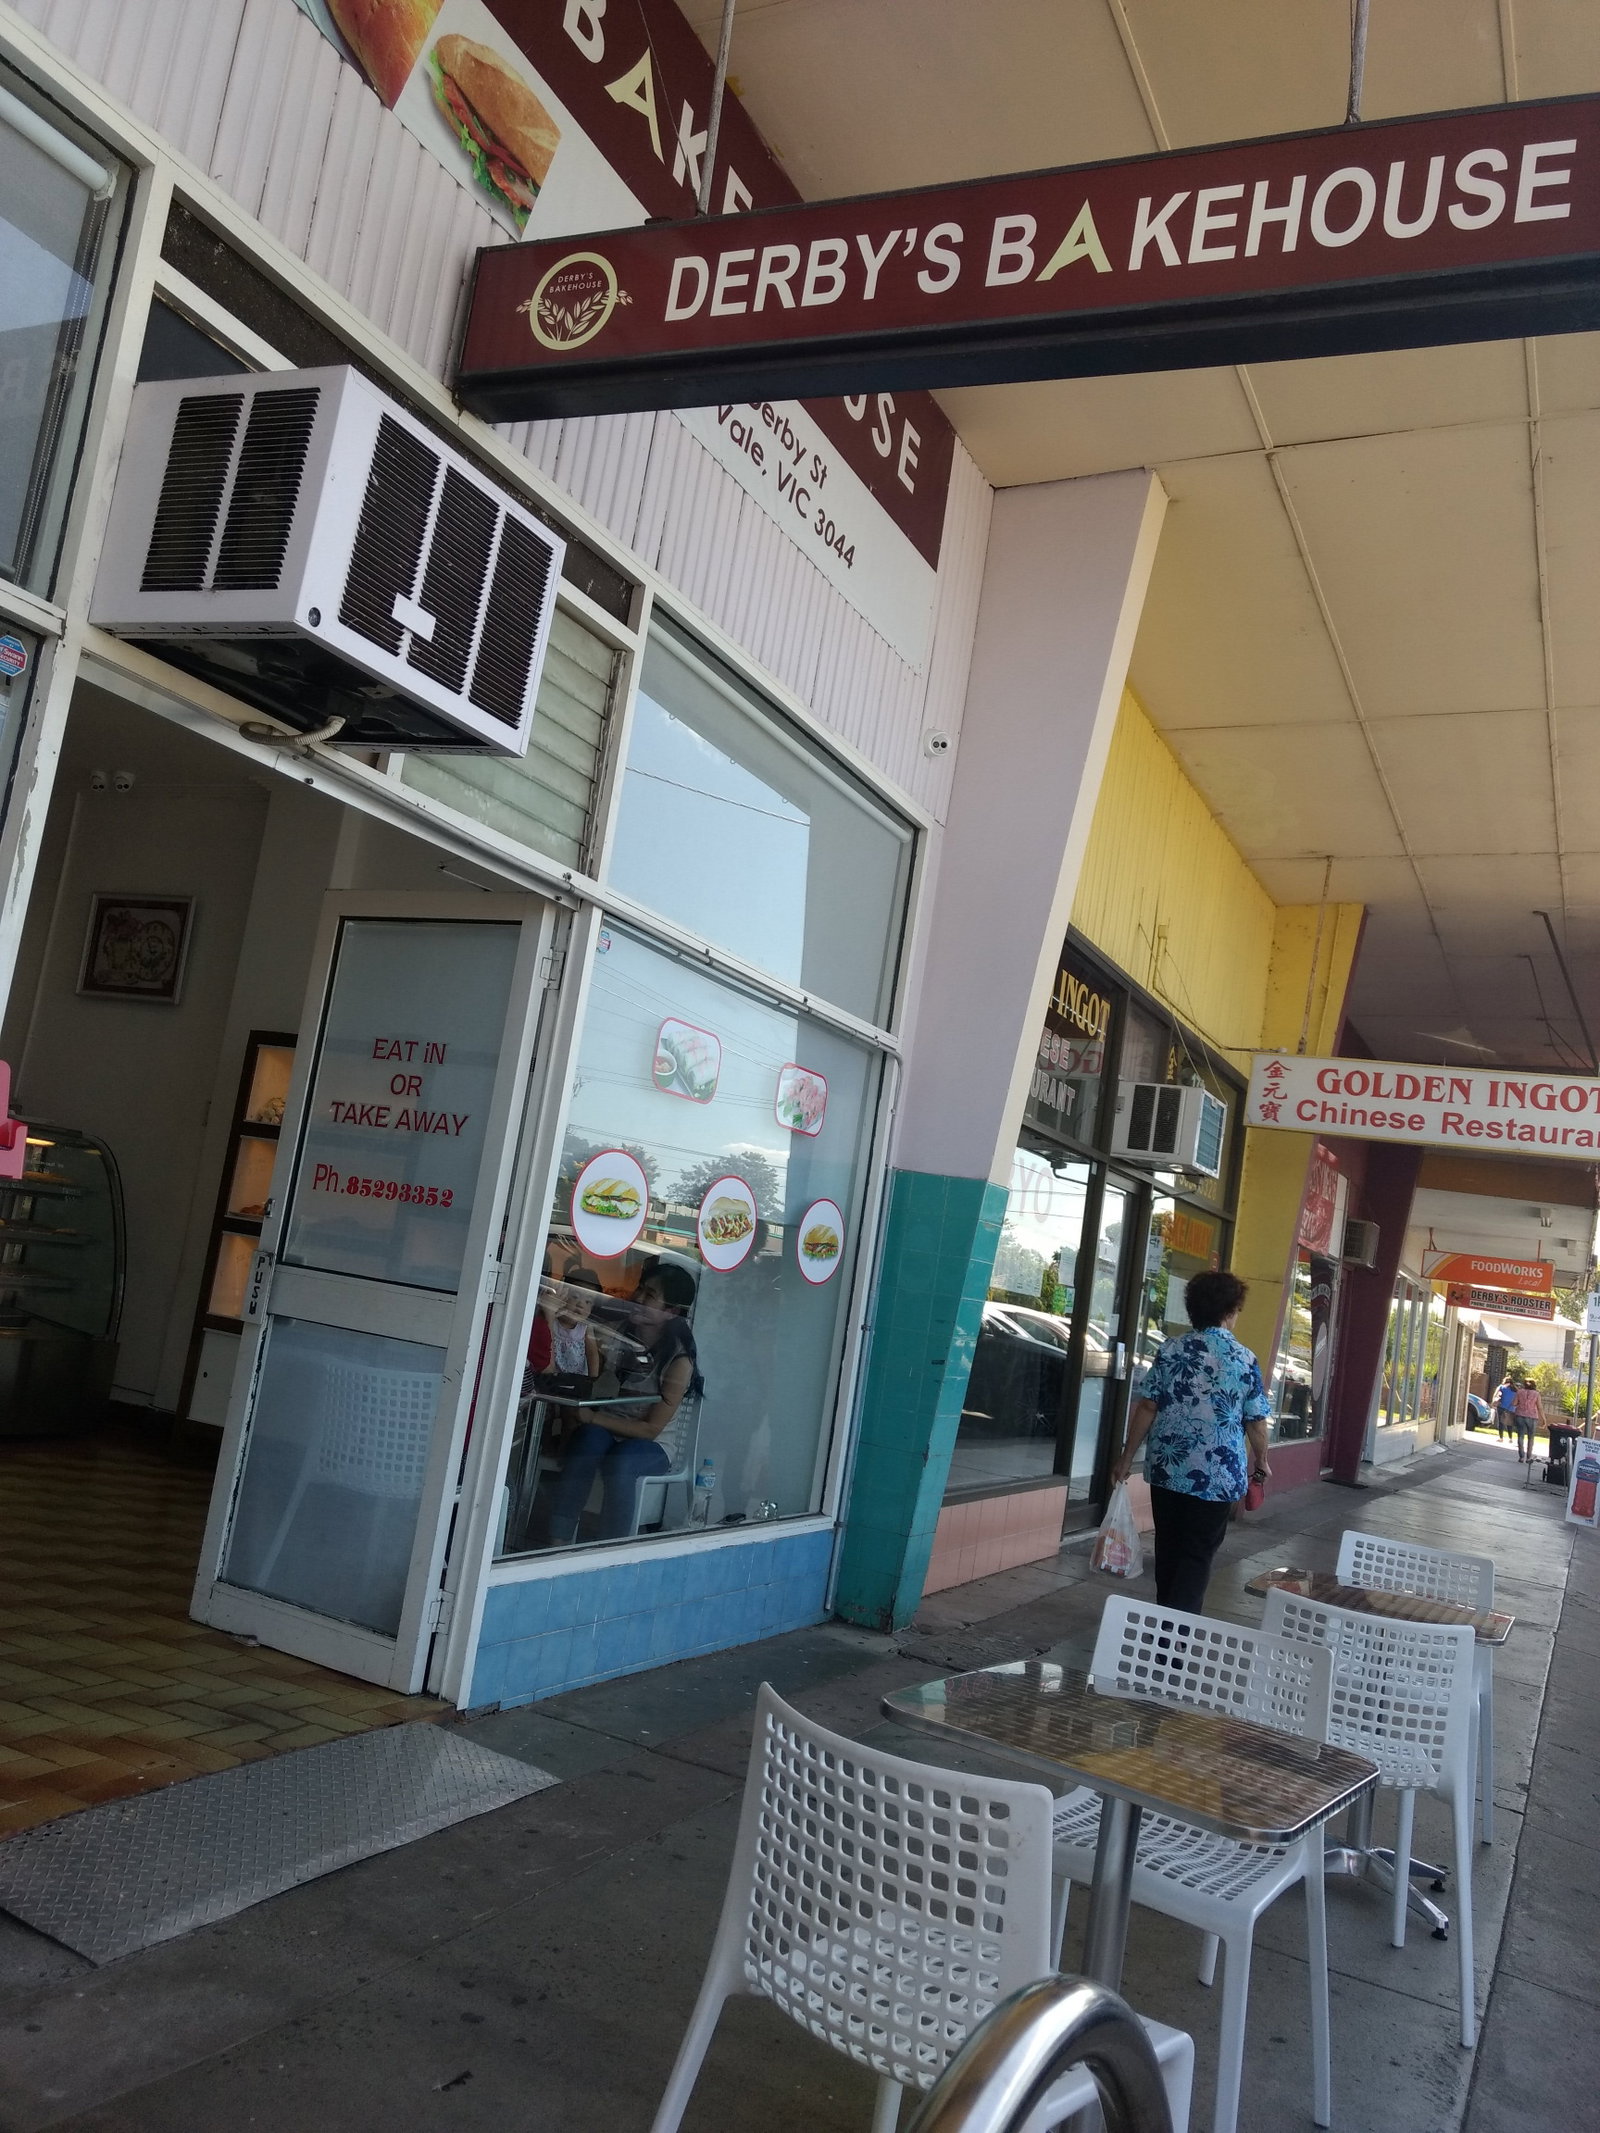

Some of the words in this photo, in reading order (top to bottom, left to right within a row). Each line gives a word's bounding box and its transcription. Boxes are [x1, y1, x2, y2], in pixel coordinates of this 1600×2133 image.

[664, 222, 964, 322] DERBY'S
[984, 139, 1578, 288] BAKEHOUSE
[549, 280, 602, 294] BAKEHOUSE
[557, 272, 593, 284] DERBY'S
[809, 454, 828, 489] St
[777, 460, 811, 519] VIC
[813, 508, 856, 570] 3044
[1056, 969, 1111, 1043] INGOT
[372, 1038, 419, 1062] EAT
[390, 1074, 424, 1097] OR
[1316, 1067, 1474, 1105] GOLDEN
[331, 1101, 391, 1128] TAKE
[395, 1109, 471, 1137] AWAY
[1296, 1099, 1426, 1131] Chinese
[1470, 1290, 1508, 1304] DERBY'S
[1511, 1296, 1551, 1310] ROOSTER
